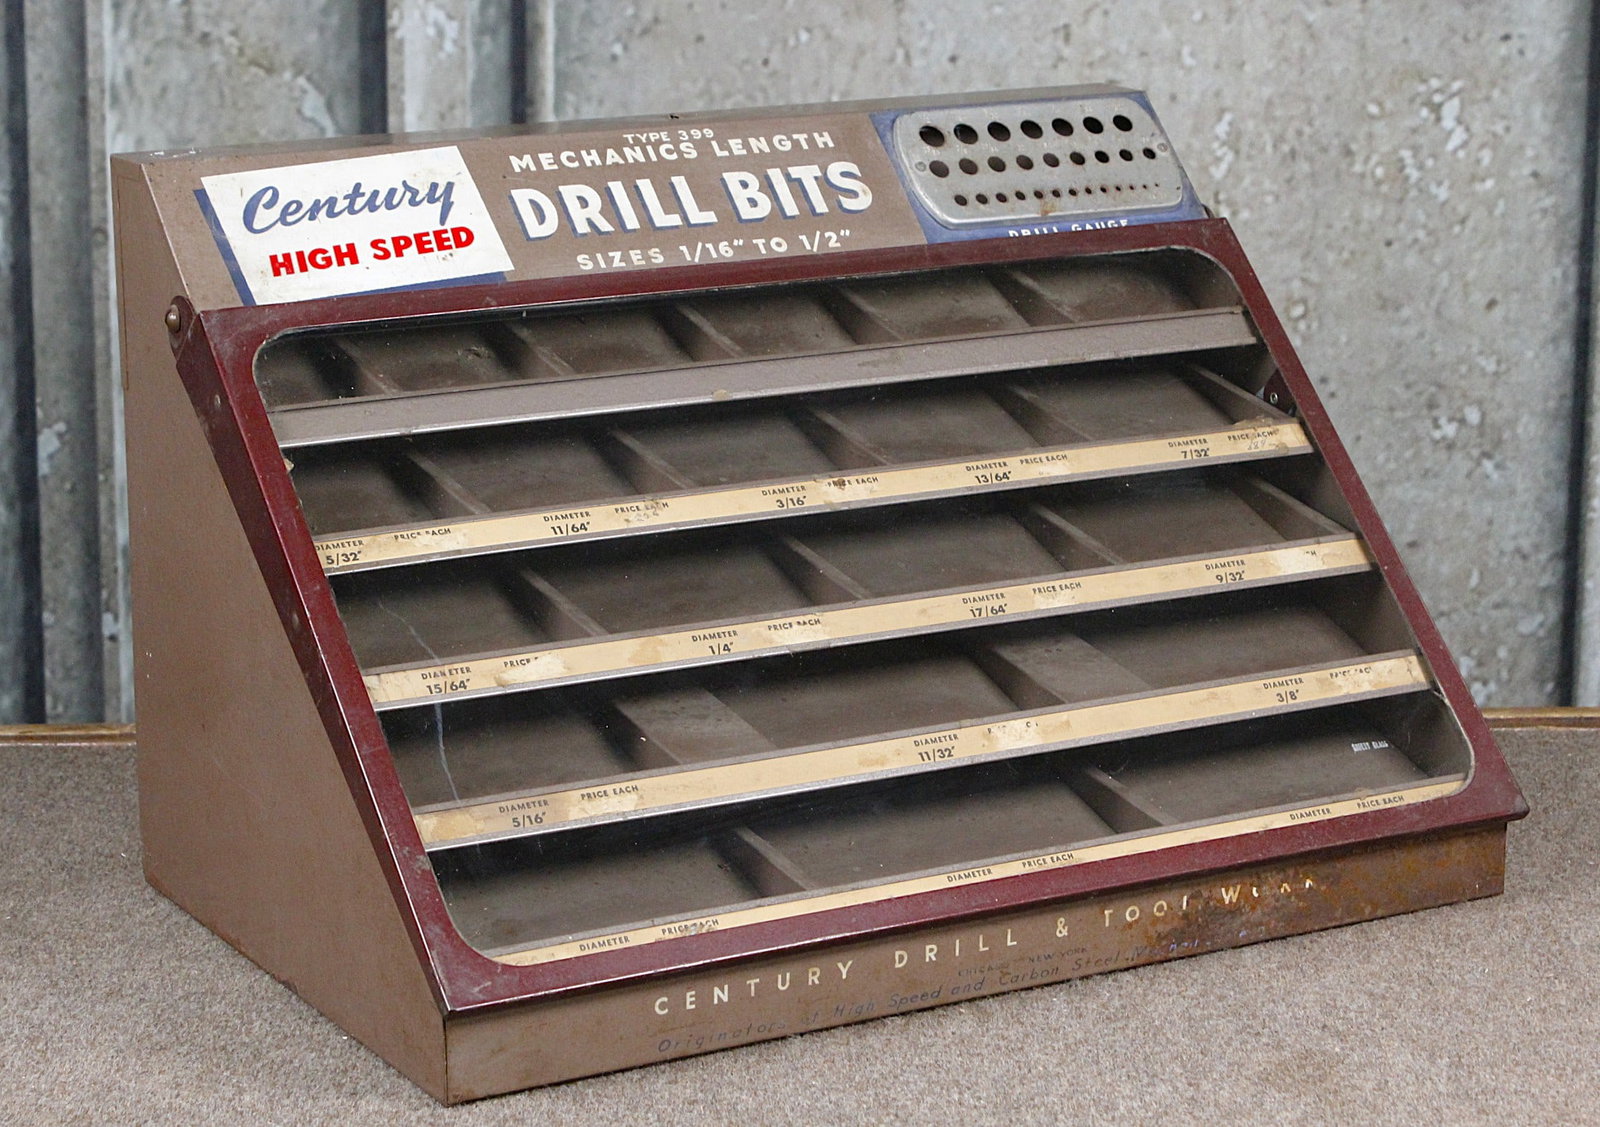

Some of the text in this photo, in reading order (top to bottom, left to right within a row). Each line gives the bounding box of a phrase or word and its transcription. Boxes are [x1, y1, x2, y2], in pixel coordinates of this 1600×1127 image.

[623, 128, 714, 144] TYPE 399
[509, 131, 835, 173] MECHANICS LENGTH
[242, 180, 455, 234] Century
[509, 161, 873, 241] DRILL BITS
[269, 226, 475, 277] HIGH SPEED
[576, 229, 851, 270] SIZES 1/16" TO 1/2"
[1253, 431, 1273, 439] ACH
[1168, 438, 1208, 447] DIAMETER
[1019, 454, 1068, 465] PRICE EACH
[1181, 447, 1210, 460] 7/32"
[965, 461, 1009, 472] DIAMETER
[856, 476, 879, 485] EACH
[974, 470, 1012, 484] 13/64"
[762, 485, 806, 496] DIAMETER
[776, 495, 807, 509] 3/16"
[543, 511, 591, 522] DIAMETER
[614, 505, 641, 514] PRICE
[550, 521, 591, 536] 11/64"
[315, 540, 364, 552] DIAMETER
[326, 550, 362, 566] 5/32"
[1205, 559, 1246, 571] DIAMETER
[1215, 570, 1245, 584] 9/32"
[1032, 581, 1082, 594] PRICE EACH
[962, 592, 1006, 604] DIAMETER
[969, 603, 1008, 618] 17/64"
[767, 622, 793, 631] PRICE
[691, 630, 739, 642] DIAMETER
[708, 641, 734, 655] 1/4"
[426, 679, 471, 695] 15/64"
[1263, 677, 1304, 689] DIAMETER
[1276, 689, 1299, 703] 3/8"
[913, 733, 959, 747] DIAMETER
[918, 746, 956, 762] 11/32"
[580, 785, 639, 801] PRICE EACH
[498, 799, 550, 814] DIAMETER
[1356, 796, 1405, 809] PRICE EACH
[512, 811, 547, 828] 5/16"
[1290, 808, 1331, 821] DIAMETER
[1022, 853, 1074, 868] PRICE EACH
[947, 868, 993, 883] DIAMETER
[579, 935, 631, 951] DIAMETER
[654, 960, 853, 1015] CENTURY
[894, 928, 1017, 968] DRILL
[1055, 917, 1069, 938] &
[833, 1002, 875, 1018] High
[888, 984, 943, 1009] Speed
[951, 976, 985, 995] and
[999, 965, 1059, 985] Carbon
[1072, 951, 1120, 971] Steel
